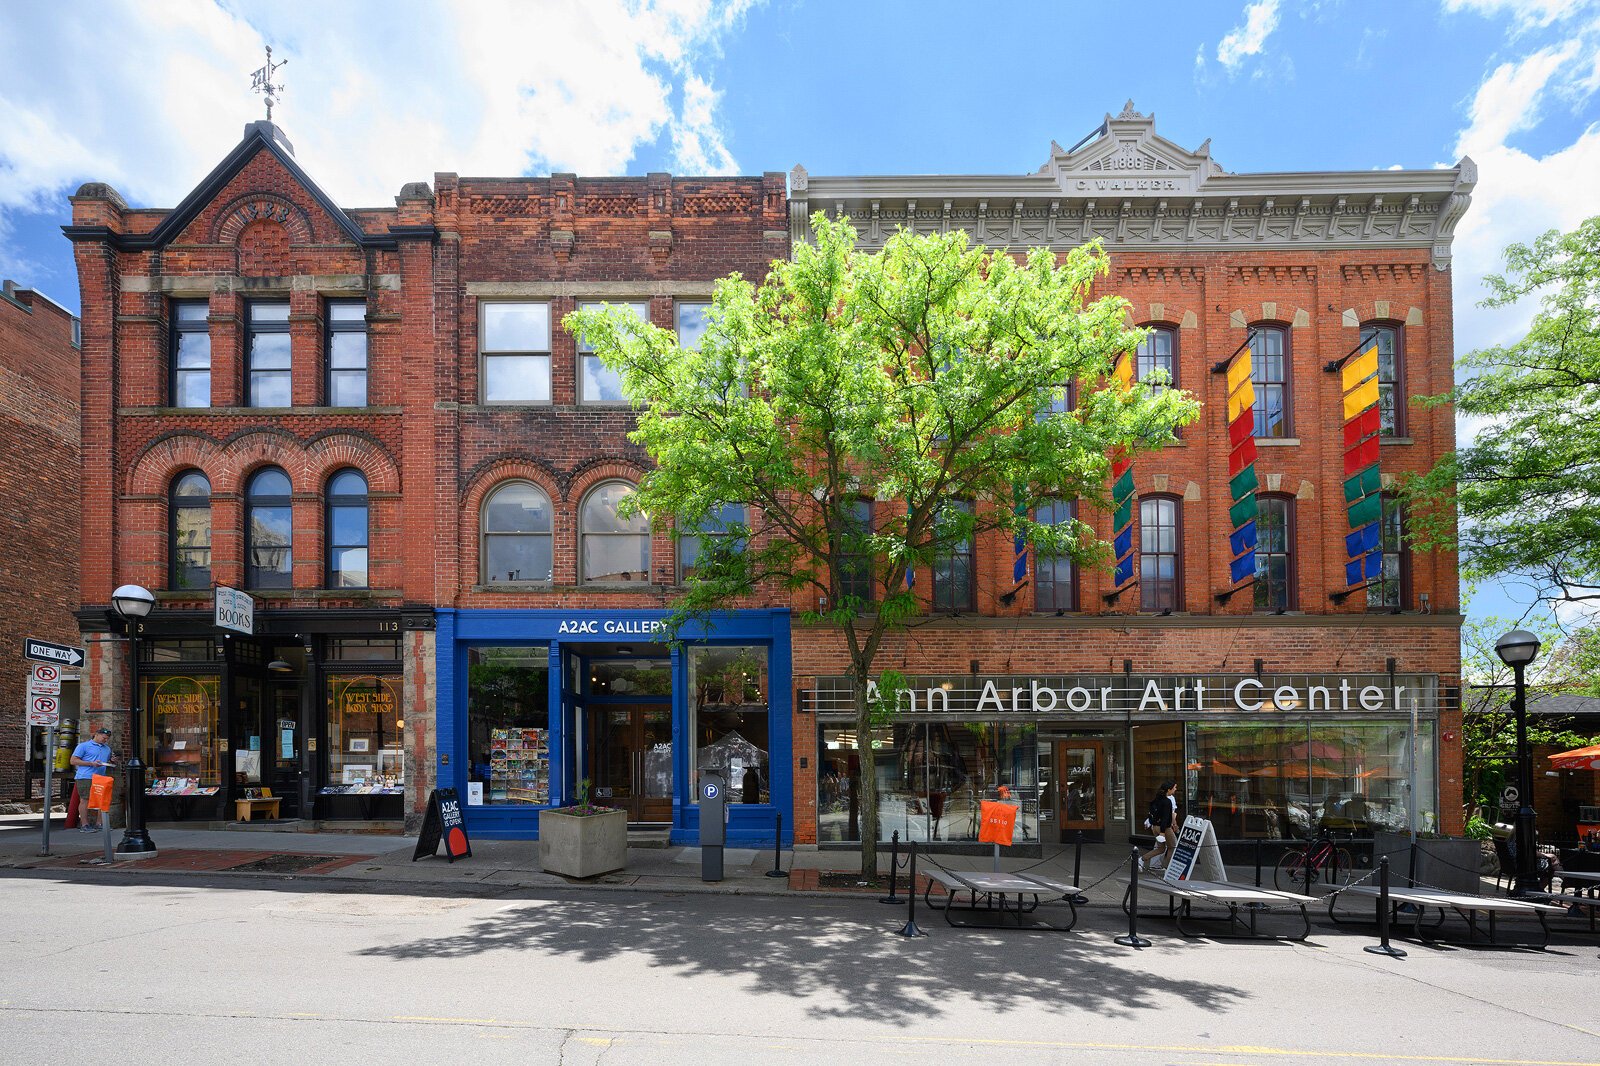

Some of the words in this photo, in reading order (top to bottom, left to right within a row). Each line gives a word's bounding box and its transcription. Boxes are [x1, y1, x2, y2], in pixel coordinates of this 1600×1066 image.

[1113, 157, 1143, 170] 1886
[235, 201, 290, 224] 1888
[219, 607, 251, 628] BOOKS
[379, 622, 398, 631] 113
[558, 620, 599, 634] A2AC
[603, 620, 668, 634] GALLERY
[32, 645, 51, 656] ONE
[54, 649, 72, 660] WAY
[157, 694, 181, 703] WEST
[184, 694, 203, 703] SIDE
[345, 693, 370, 702] WEST
[372, 693, 392, 702] SIDE
[975, 680, 1113, 712] Arbor
[1137, 679, 1206, 711] Art
[1233, 678, 1405, 711] Center
[157, 704, 180, 714] BOOK
[182, 704, 205, 714] SHOP
[345, 703, 367, 713] BOOK
[371, 703, 393, 713] SHOP
[441, 800, 459, 813] A2AC
[1181, 828, 1201, 844] A2AC
